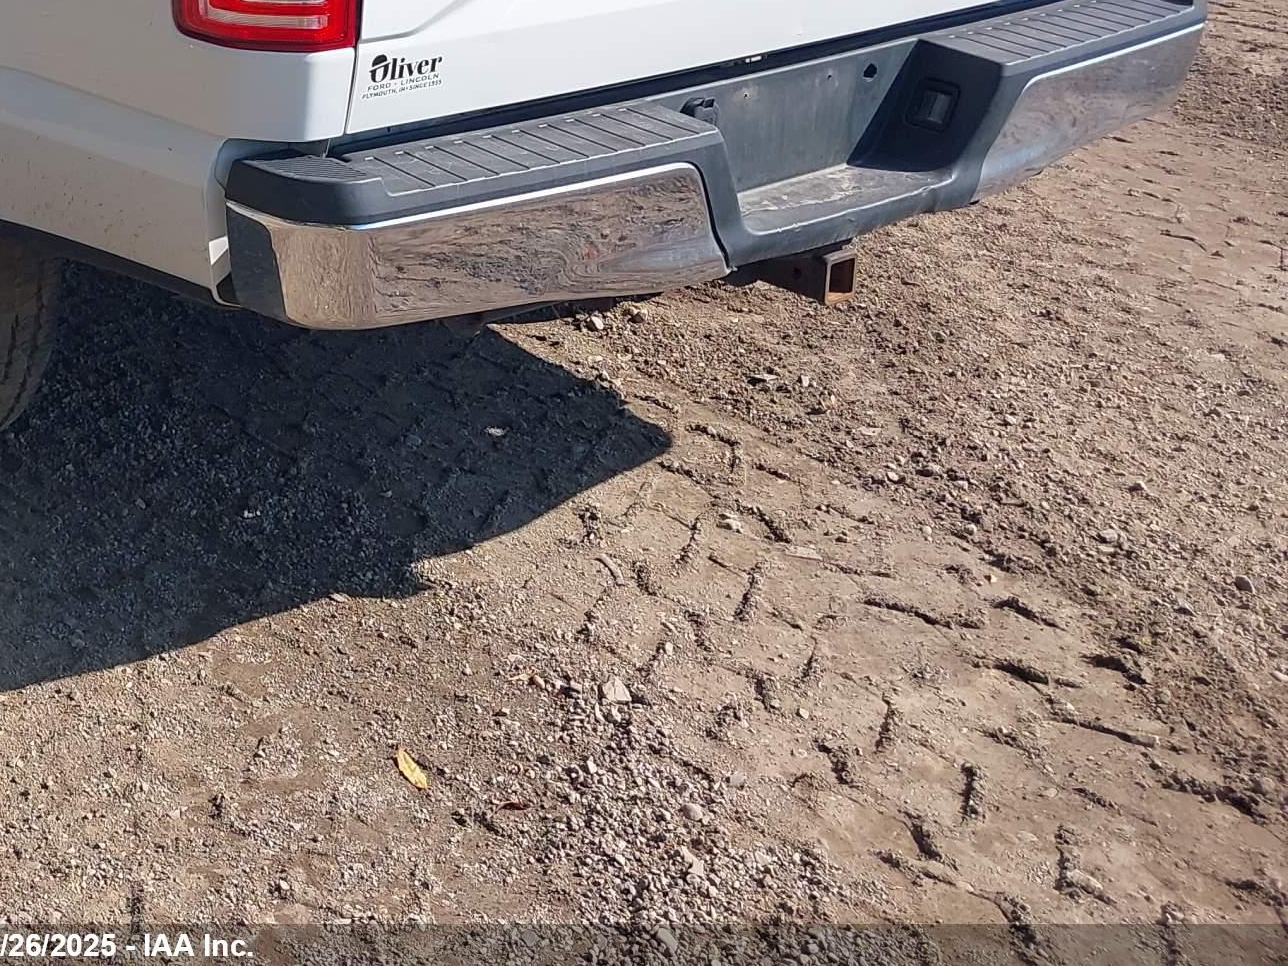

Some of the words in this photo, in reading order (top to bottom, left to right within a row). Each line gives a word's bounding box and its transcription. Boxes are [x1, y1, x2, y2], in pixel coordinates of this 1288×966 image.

[369, 54, 443, 83] Oliver
[367, 82, 392, 92] FORD
[400, 73, 440, 86] LINCOLN
